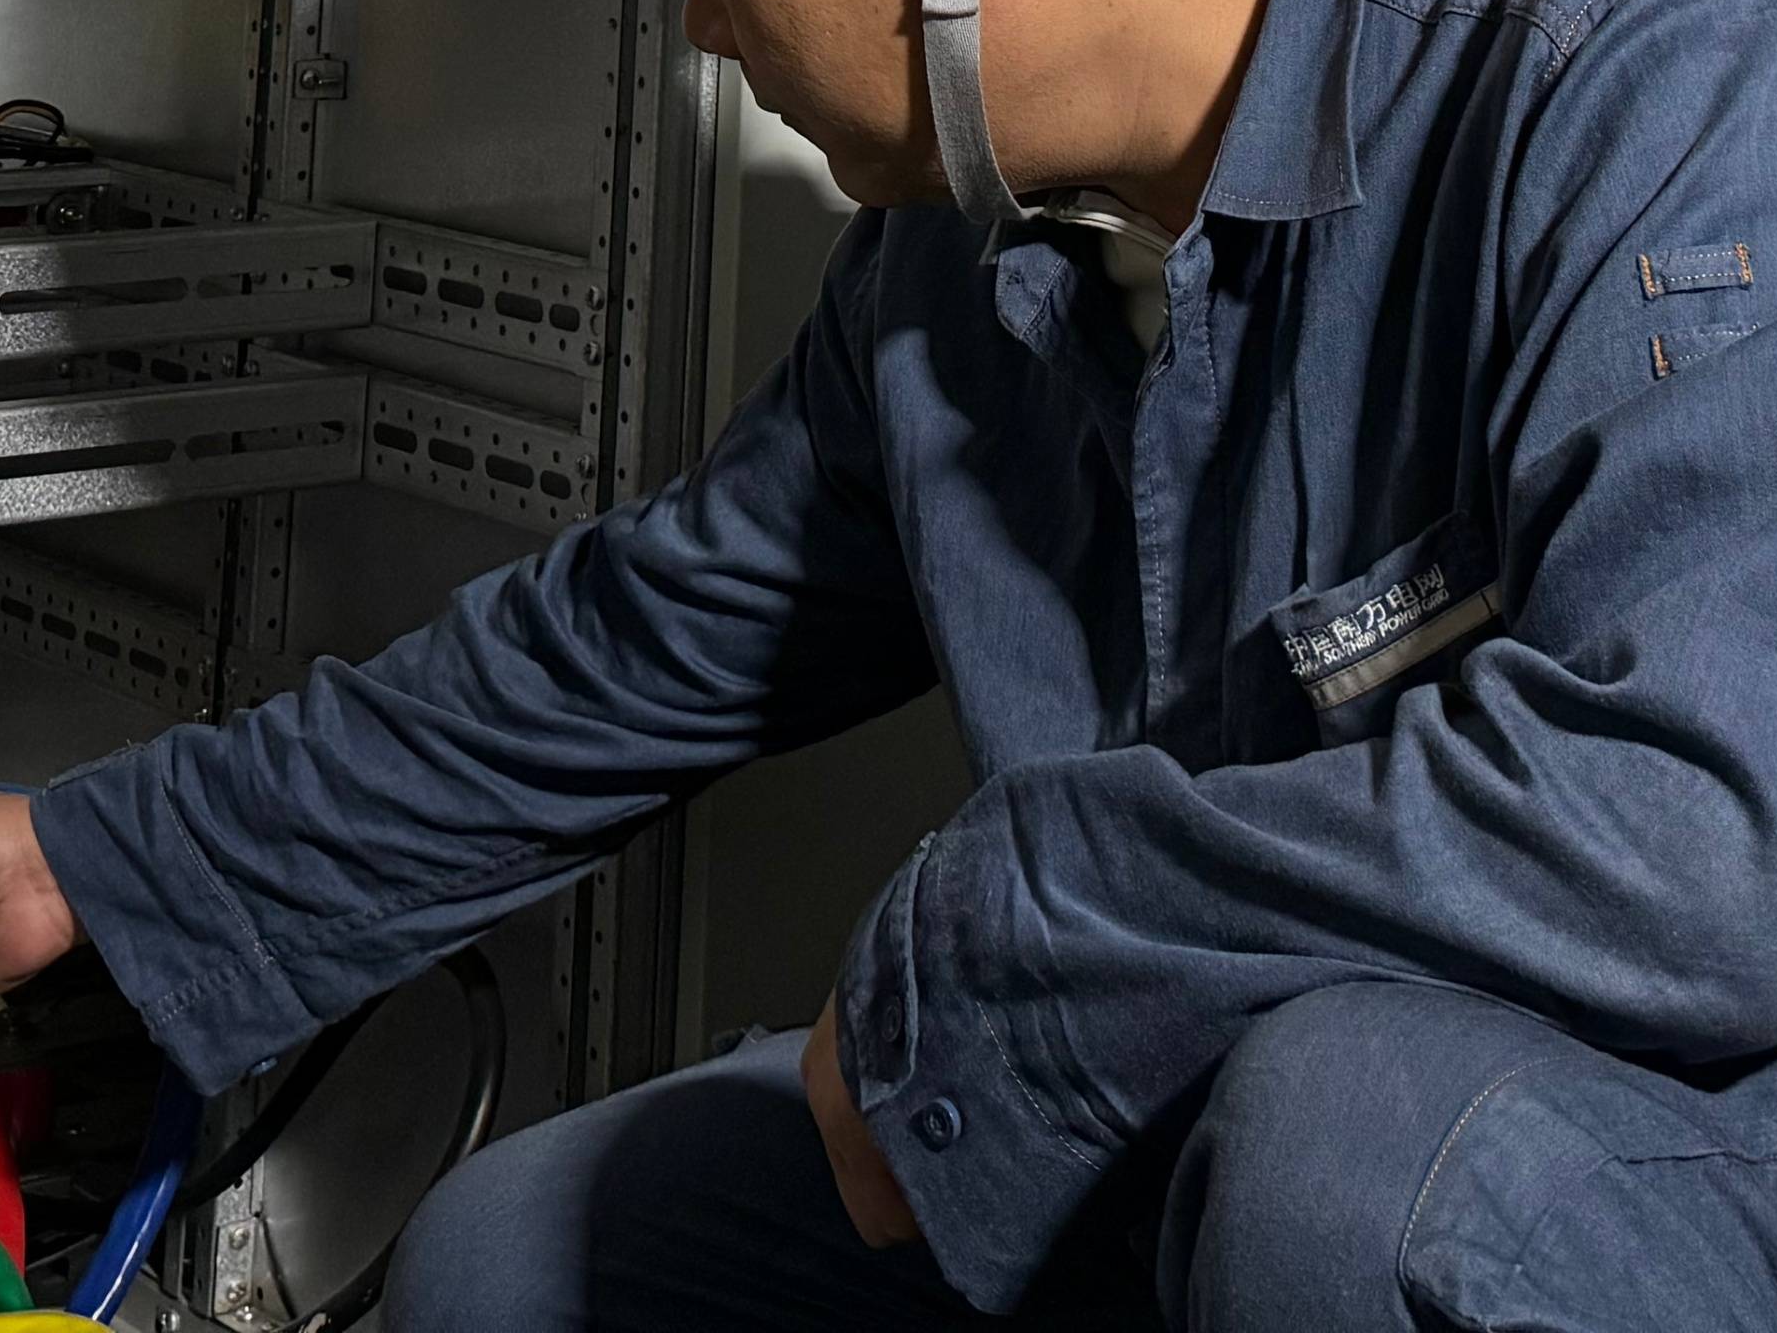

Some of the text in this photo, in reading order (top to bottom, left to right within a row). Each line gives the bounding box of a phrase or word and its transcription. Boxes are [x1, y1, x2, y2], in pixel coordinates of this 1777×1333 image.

[1284, 563, 1445, 660] 中国南方电网
